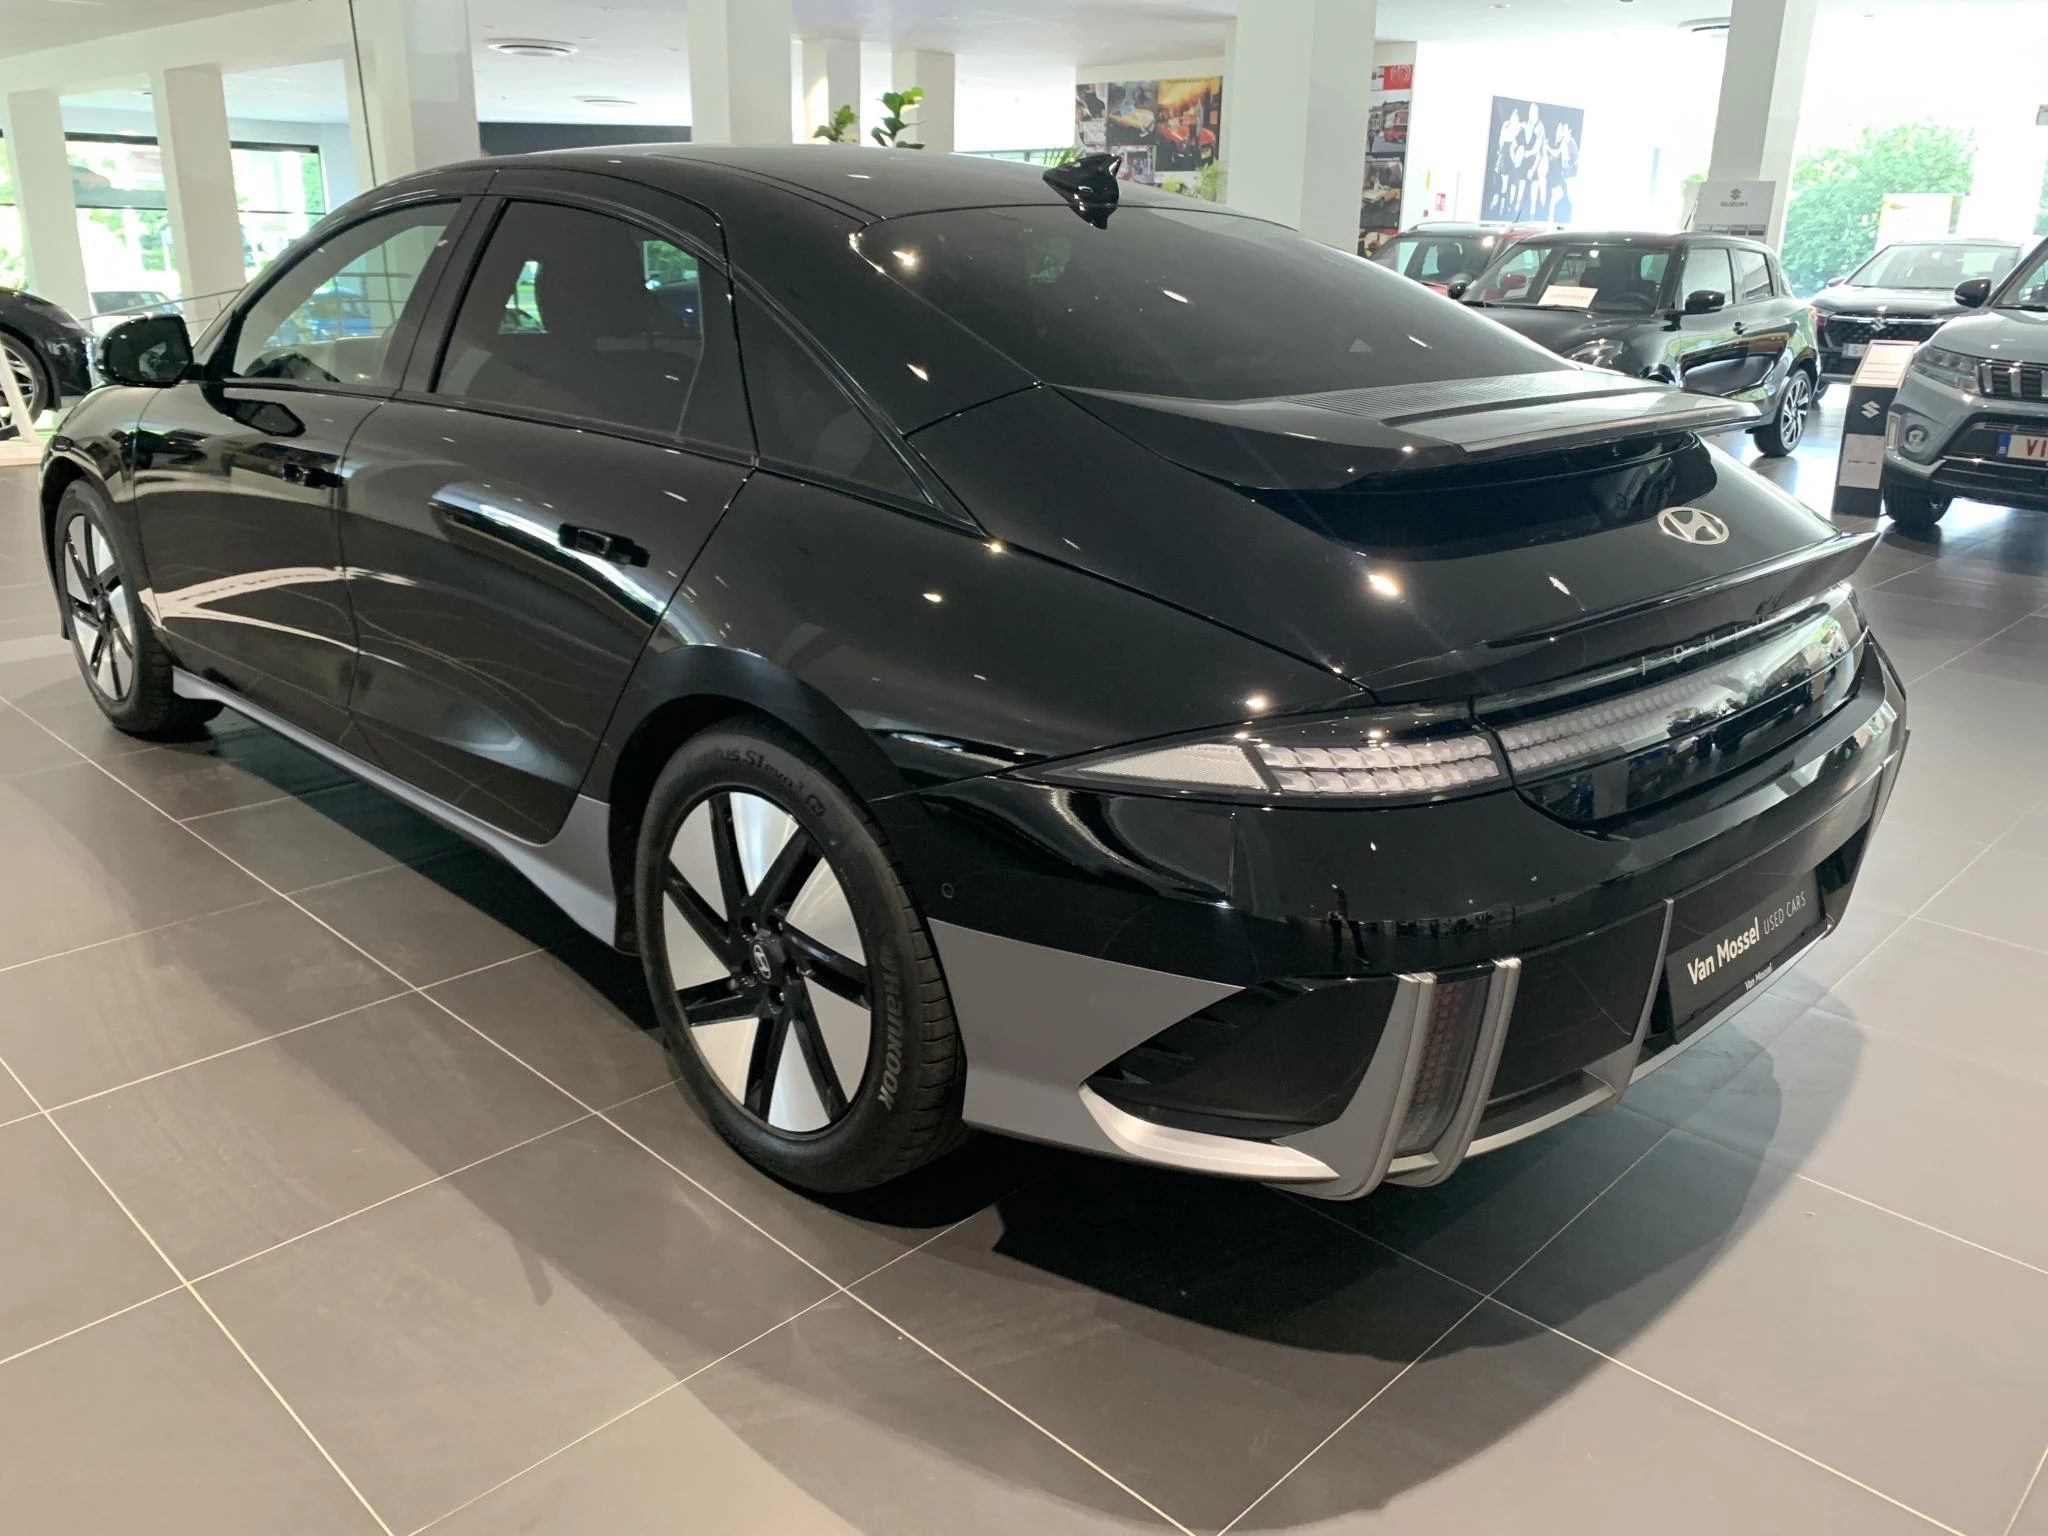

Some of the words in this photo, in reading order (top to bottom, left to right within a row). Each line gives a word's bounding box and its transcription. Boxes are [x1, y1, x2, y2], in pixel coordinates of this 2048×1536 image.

[1687, 955, 1715, 985] Van
[1716, 916, 1760, 968] Mossel
[1763, 907, 1785, 935] USED
[1786, 890, 1806, 917] CARS
